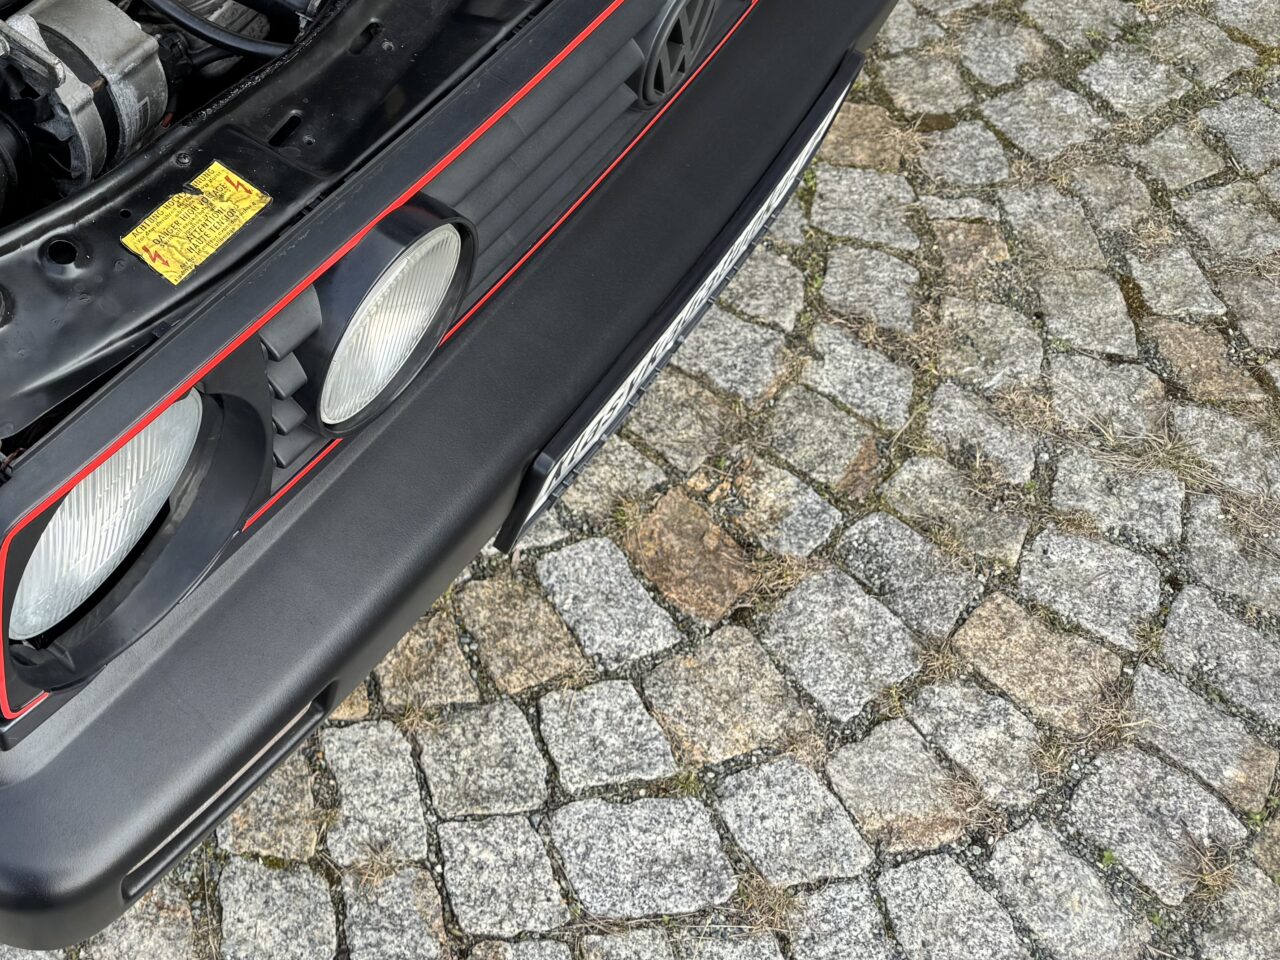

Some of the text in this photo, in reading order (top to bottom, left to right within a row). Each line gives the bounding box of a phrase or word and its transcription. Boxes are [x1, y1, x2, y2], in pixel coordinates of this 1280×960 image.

[129, 208, 165, 238] ACHTUNG
[150, 181, 228, 246] DANGER HIGH VOLTAGE
[185, 205, 241, 254] HAUTE TENSION
